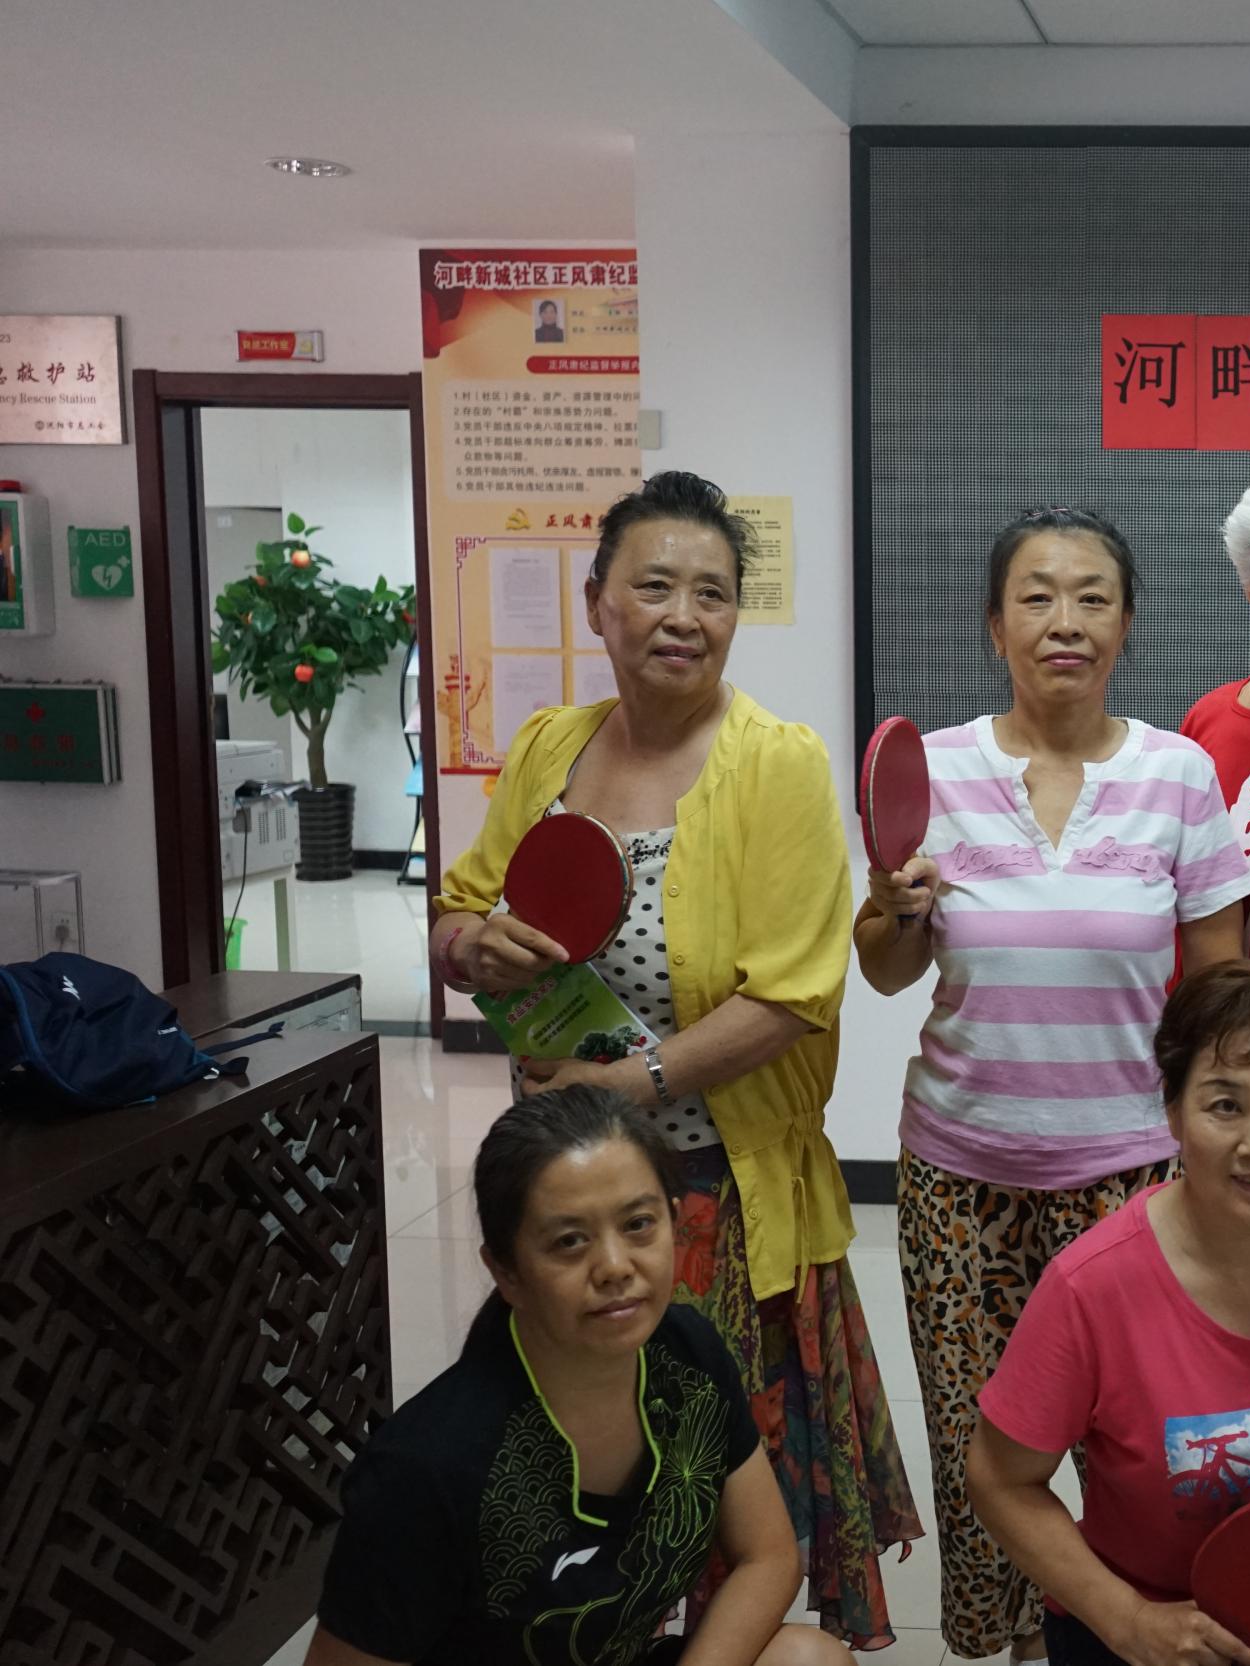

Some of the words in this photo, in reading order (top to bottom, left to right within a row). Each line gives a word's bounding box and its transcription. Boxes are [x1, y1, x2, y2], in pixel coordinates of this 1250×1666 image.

[20, 393, 56, 404] Rescue
[59, 393, 96, 404] Station
[84, 531, 127, 547] AED
